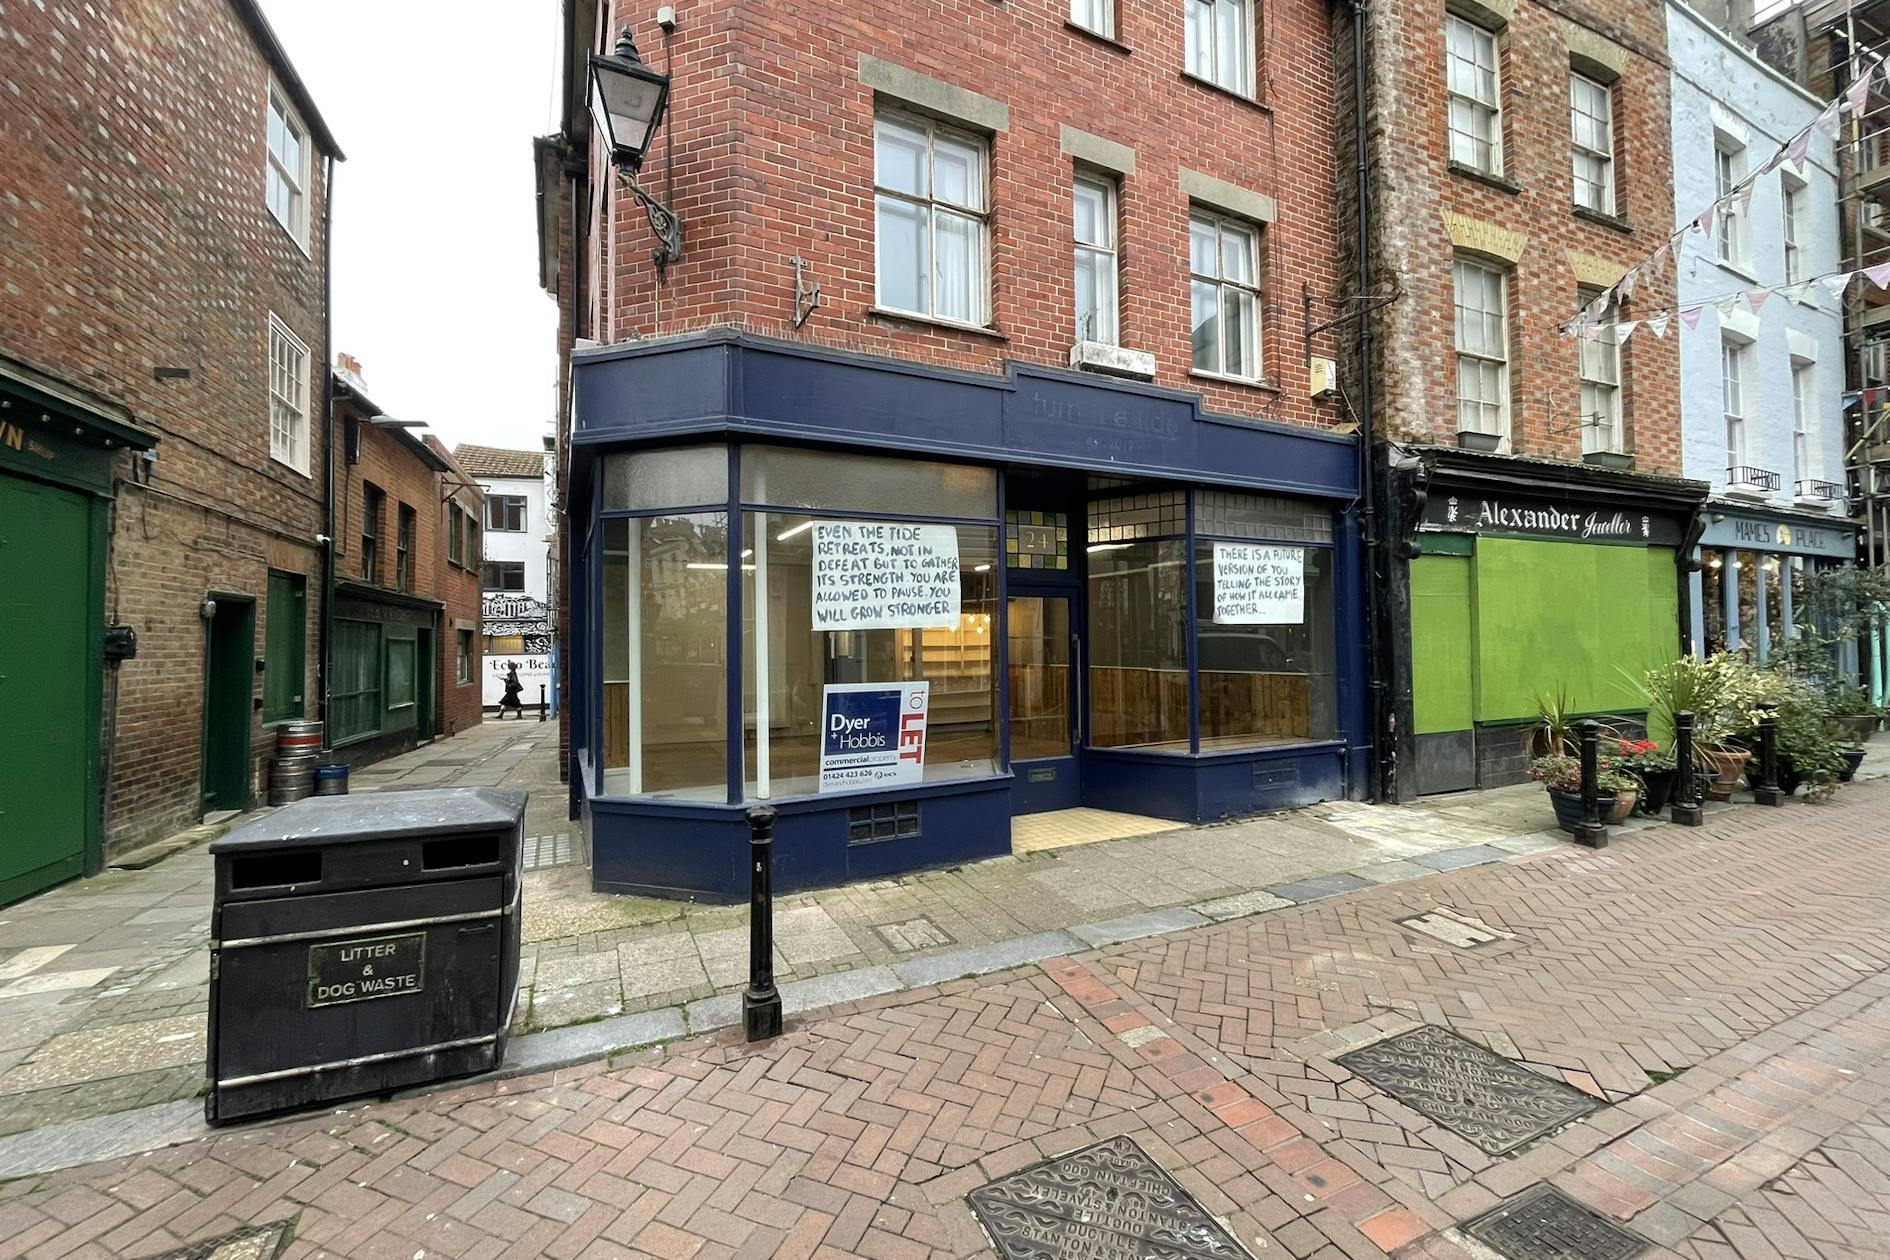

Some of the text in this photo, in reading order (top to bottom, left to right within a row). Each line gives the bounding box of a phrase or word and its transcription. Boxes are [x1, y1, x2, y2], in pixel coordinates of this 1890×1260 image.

[1476, 500, 1633, 539] Alexander Jeweller
[818, 525, 921, 541] EVEN THE TIDE
[1026, 531, 1049, 549] 24
[1735, 520, 1826, 550] MAMES PLACE
[889, 545, 914, 556] NOT
[918, 545, 933, 556] IN
[1219, 548, 1302, 563] THERE IS A FUTURE
[818, 558, 869, 572] DEFEAT
[903, 560, 918, 570] TO
[921, 557, 959, 571] GATHER
[1218, 563, 1288, 577] VERSION OF YOU
[910, 572, 931, 583] YOU
[933, 570, 956, 584] ARE
[1217, 575, 1301, 590] TELLING THE STORY
[816, 589, 868, 604] ALLOWED
[873, 588, 887, 599] TO
[929, 586, 951, 598] YOU
[1217, 592, 1227, 603] OF
[1229, 591, 1246, 601] HOW
[1248, 589, 1257, 600] IT
[1274, 588, 1298, 601] CAME
[817, 600, 950, 623] WILL GROW STRONGER
[489, 659, 522, 671] Eco
[830, 713, 870, 734] Dyer
[899, 690, 925, 764] to LET
[839, 732, 886, 750] Hobbis
[823, 770, 873, 781] 01424 423 626
[341, 944, 396, 962] LITTER
[362, 964, 374, 976] &
[317, 974, 416, 1000] DOG WASTE
[1096, 1170, 1170, 1197] CHIEFTAIN
[1031, 1184, 1103, 1211] STAVELEY
[1072, 1208, 1142, 1234] DUCTILE
[1116, 1204, 1187, 1231] STANTON
[1021, 1226, 1092, 1252] STANTON
[1095, 1244, 1104, 1257] &
[1066, 1222, 1138, 1249] DUCTILE
